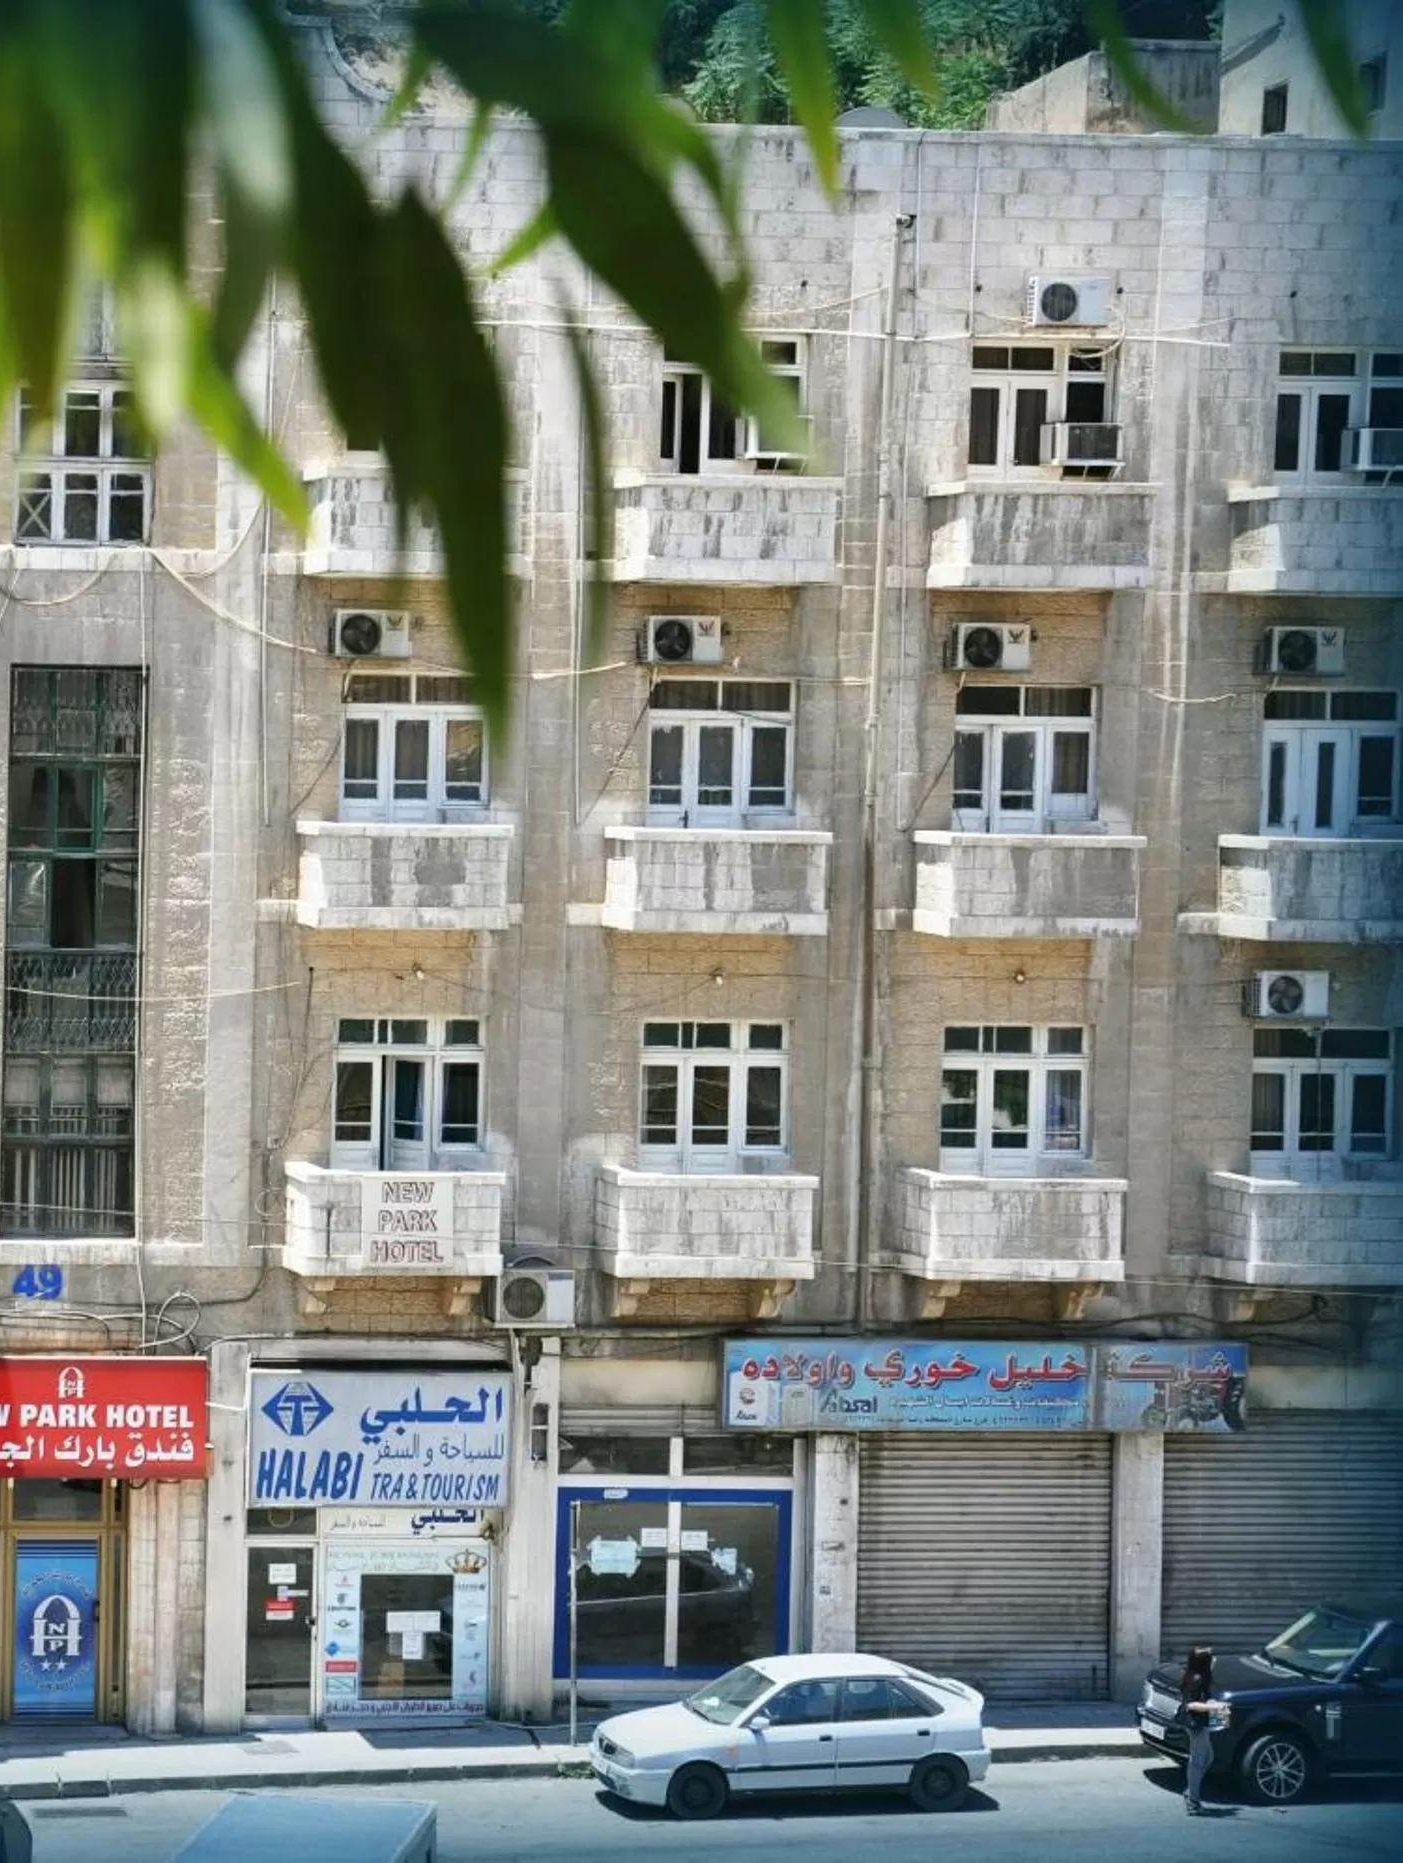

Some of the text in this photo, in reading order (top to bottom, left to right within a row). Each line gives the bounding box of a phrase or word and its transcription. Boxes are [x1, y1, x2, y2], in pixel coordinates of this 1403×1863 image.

[381, 1181, 435, 1204] NEW
[377, 1209, 439, 1233] PARK
[370, 1240, 446, 1264] HOTEL
[12, 1263, 64, 1300] 49
[863, 1348, 981, 1390] خوري
[986, 1349, 1089, 1392] خليل
[19, 1404, 99, 1429] PARK
[105, 1404, 195, 1429] HOTEL
[359, 1383, 504, 1445] الحلبي
[54, 1433, 117, 1470] بارك
[124, 1431, 195, 1468] فندق
[372, 1433, 421, 1466] السفر
[439, 1432, 505, 1463] للسياحة
[255, 1448, 365, 1500] HALABI
